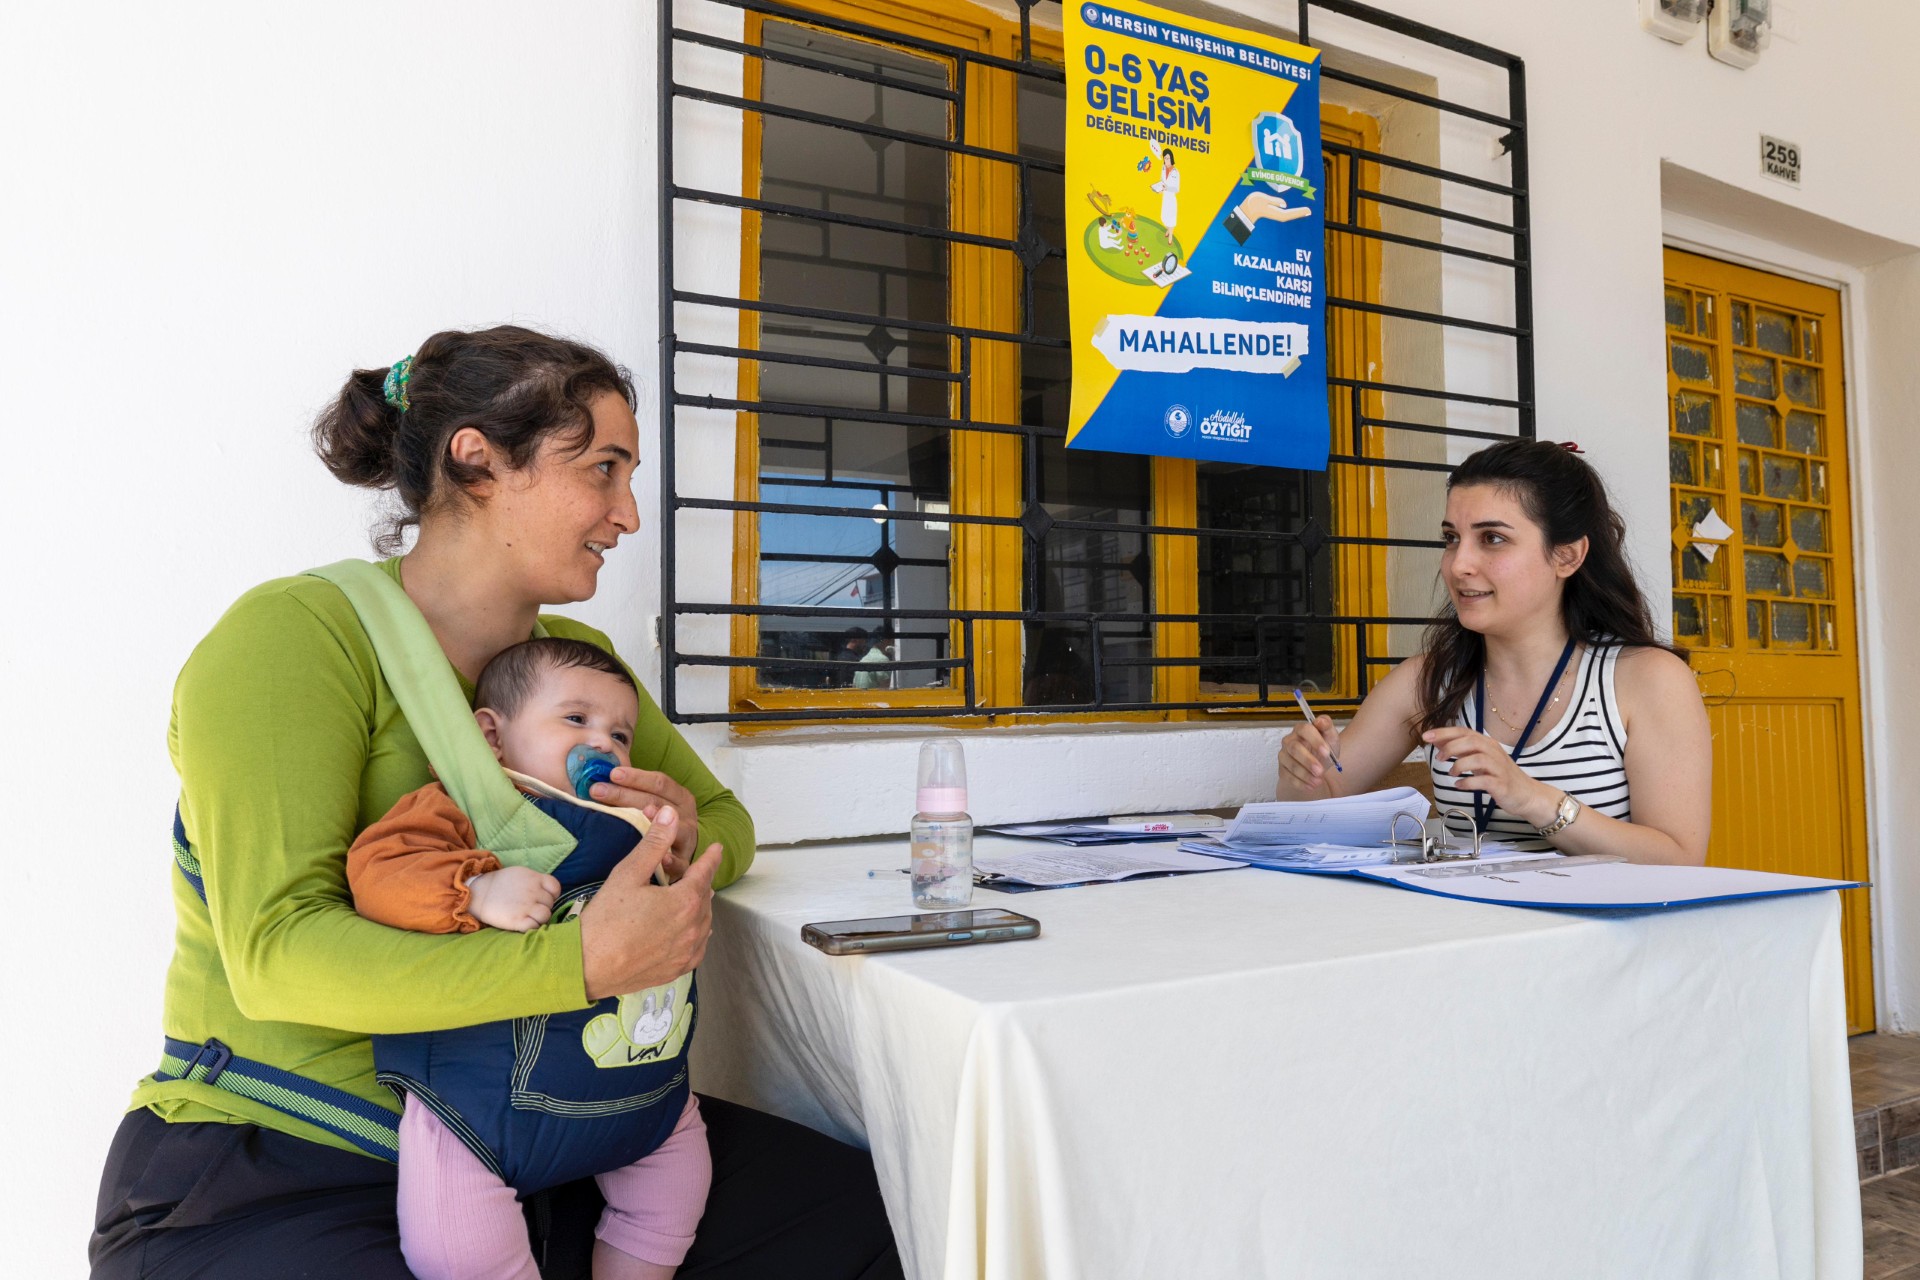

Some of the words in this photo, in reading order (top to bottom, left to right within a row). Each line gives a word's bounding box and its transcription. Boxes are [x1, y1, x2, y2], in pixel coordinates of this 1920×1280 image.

[1102, 12, 1157, 38] MERSİN
[1161, 27, 1235, 58] YENİŞEHİR
[1239, 49, 1311, 81] BELEDİYESİ
[1084, 44, 1142, 84] 0-6
[1147, 59, 1210, 103] YAŞ
[1086, 79, 1211, 135] GELİŞİM
[1275, 173, 1305, 188] GÜVENDE
[1767, 161, 1797, 181] KAHVE
[1233, 253, 1312, 278] KAZALARINA
[1295, 248, 1311, 263] EV
[1212, 280, 1311, 309] BİLİNÇLENDİRME
[1276, 275, 1312, 293] KARŞI
[1119, 328, 1292, 357] MAHALLENDE!
[1210, 409, 1245, 426] Abdullah
